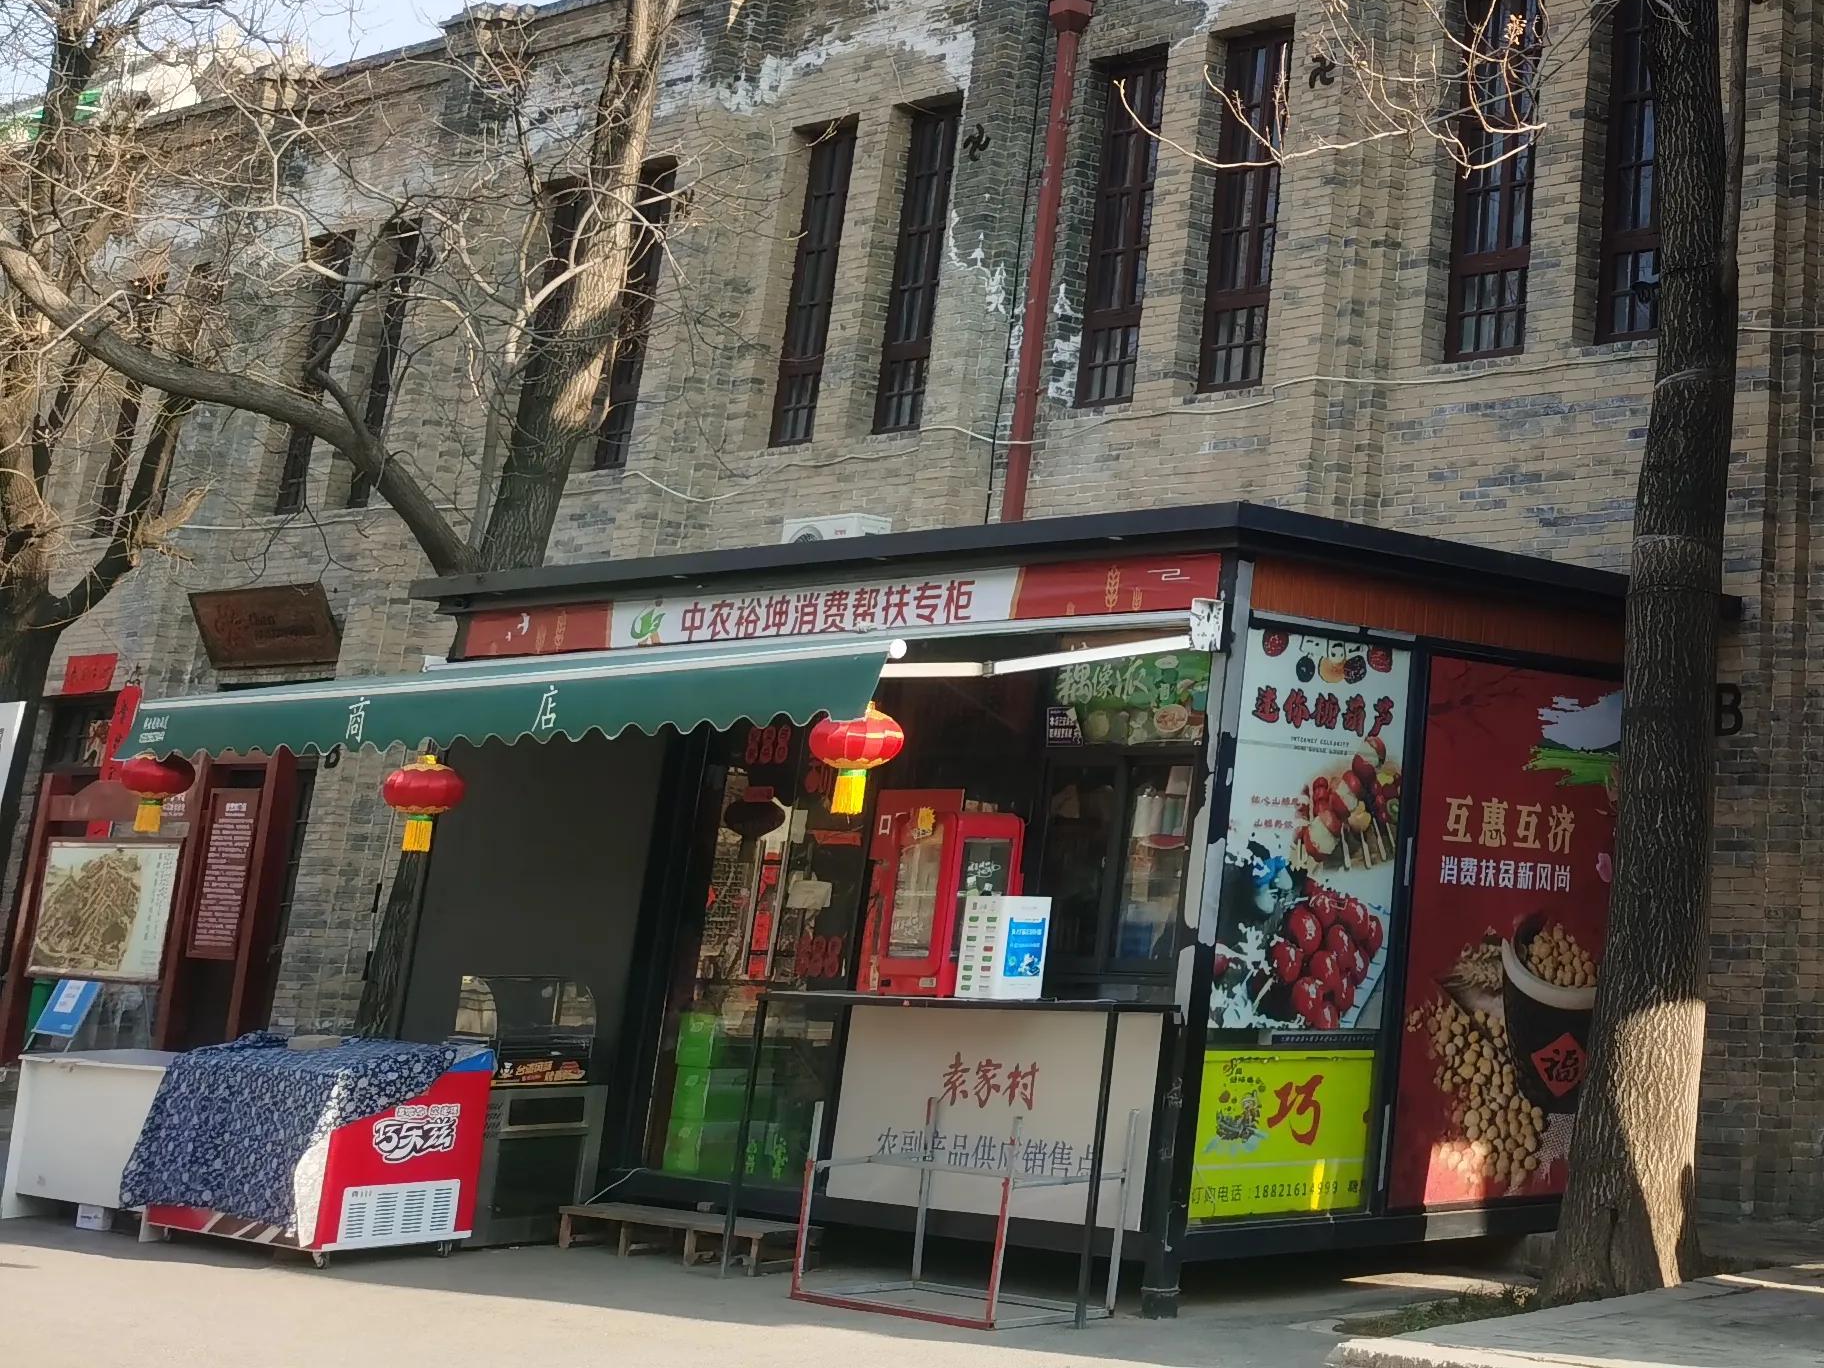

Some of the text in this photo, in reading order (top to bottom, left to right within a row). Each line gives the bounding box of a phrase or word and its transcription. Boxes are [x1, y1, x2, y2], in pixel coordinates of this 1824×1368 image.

[681, 579, 976, 640] 中农裕坤消费帮扶专柜
[1252, 685, 1395, 738] 迷你糖葫芦
[1714, 683, 1743, 737] B
[1442, 795, 1575, 854] 互惠互济
[1439, 855, 1571, 893] 消费扶贫新风尚
[1267, 1074, 1325, 1146] 巧
[374, 1116, 457, 1163] 巧乐兹
